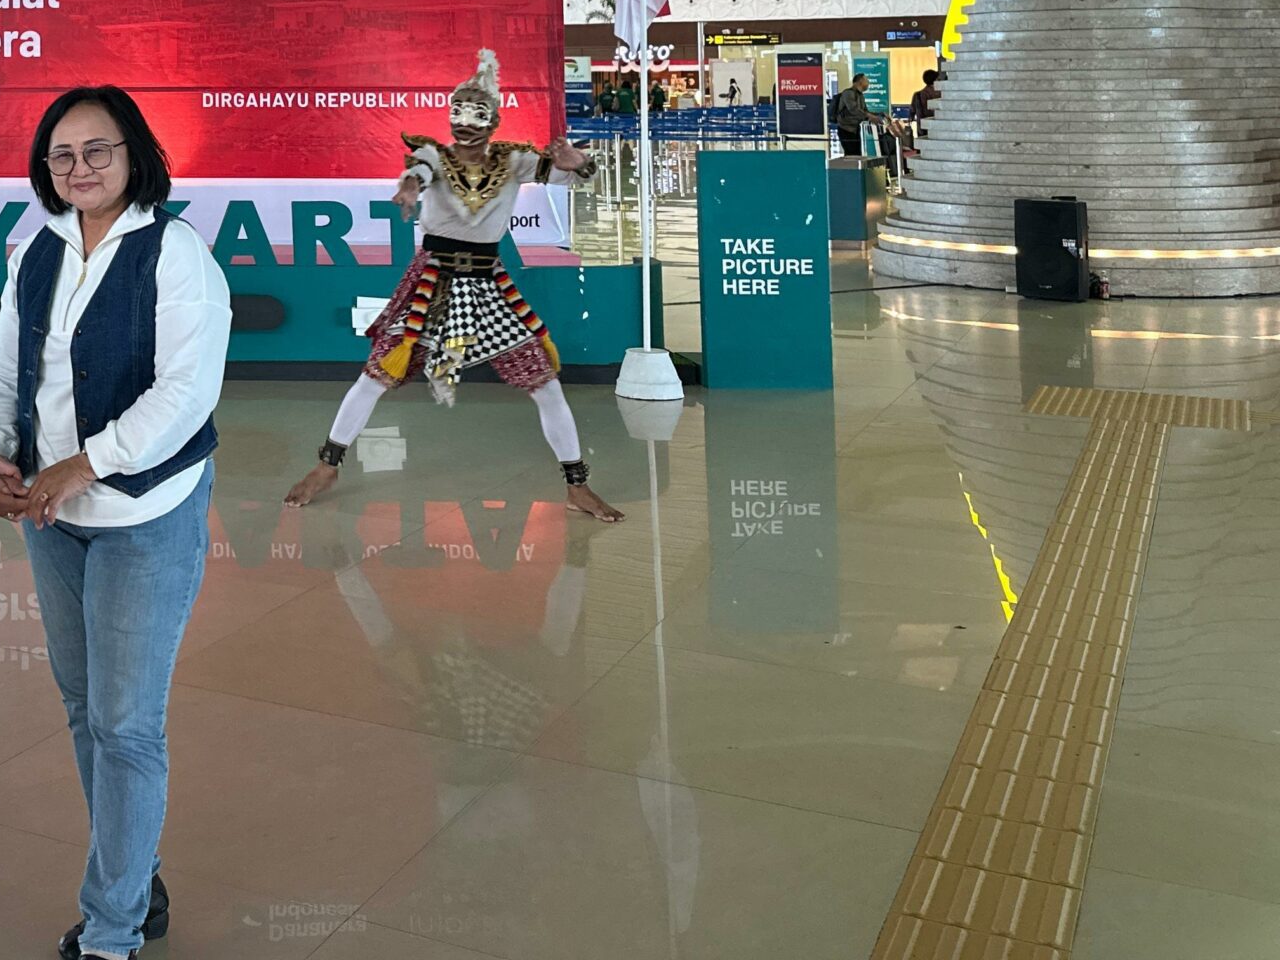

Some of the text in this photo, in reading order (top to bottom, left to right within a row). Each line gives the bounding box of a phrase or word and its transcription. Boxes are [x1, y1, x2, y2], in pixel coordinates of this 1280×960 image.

[202, 92, 519, 108] DIRGAHAYU REPUBLIK INDIA
[510, 213, 541, 231] port
[720, 238, 775, 255] TAKE
[722, 258, 814, 275] PICTURE
[723, 279, 780, 295] HERE
